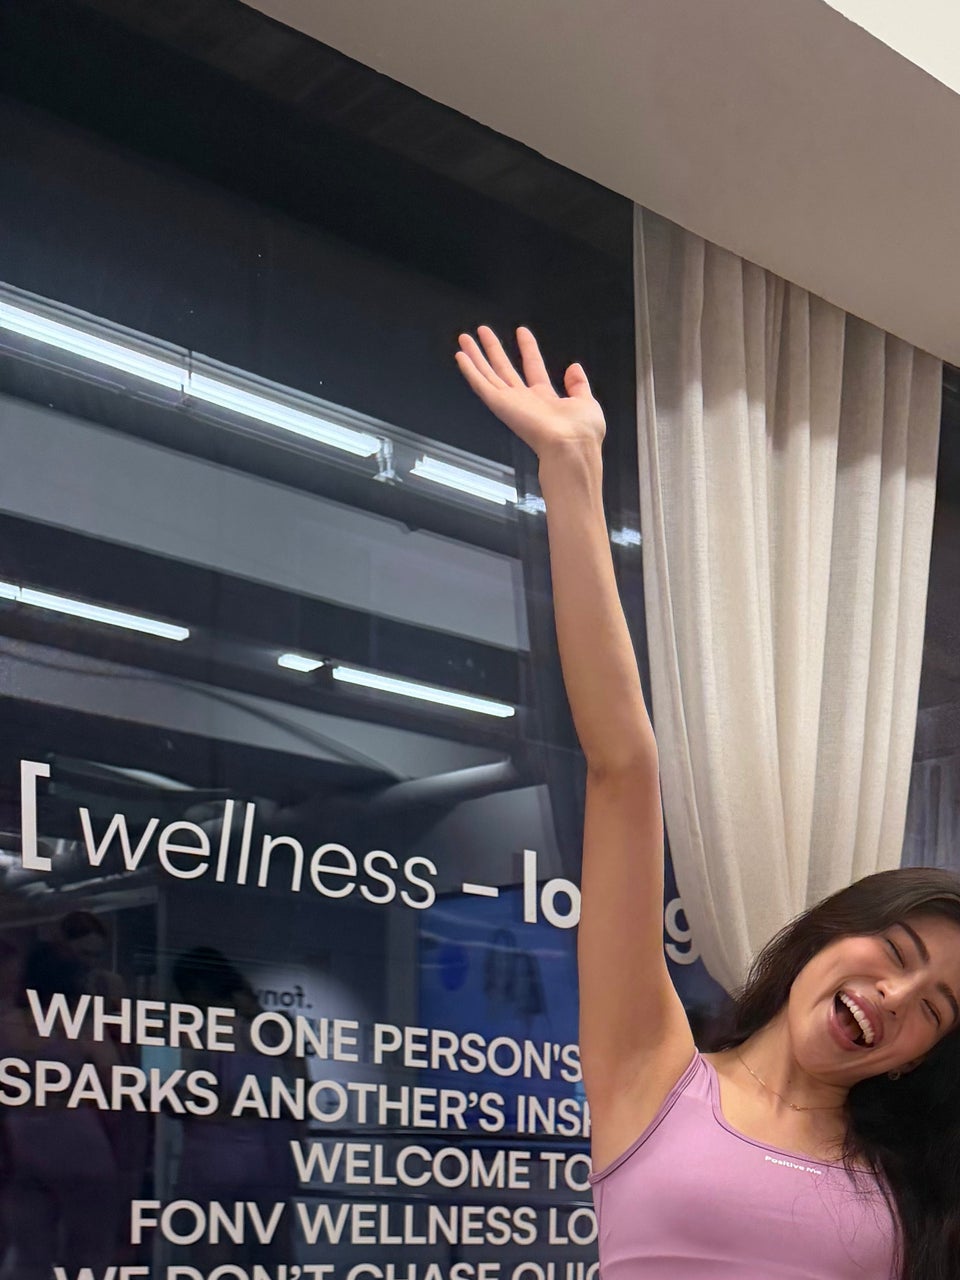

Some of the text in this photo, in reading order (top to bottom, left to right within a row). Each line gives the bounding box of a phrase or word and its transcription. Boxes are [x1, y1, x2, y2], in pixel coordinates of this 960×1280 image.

[79, 799, 438, 909] wellness
[26, 988, 583, 1083] WHERE ONE PERSON'S
[0, 1057, 218, 1115] SPARKS
[290, 1140, 594, 1192] WELCOME TO
[764, 1155, 805, 1171] Positive
[131, 1199, 285, 1245] FONV
[296, 1202, 537, 1245] WELLNESS
